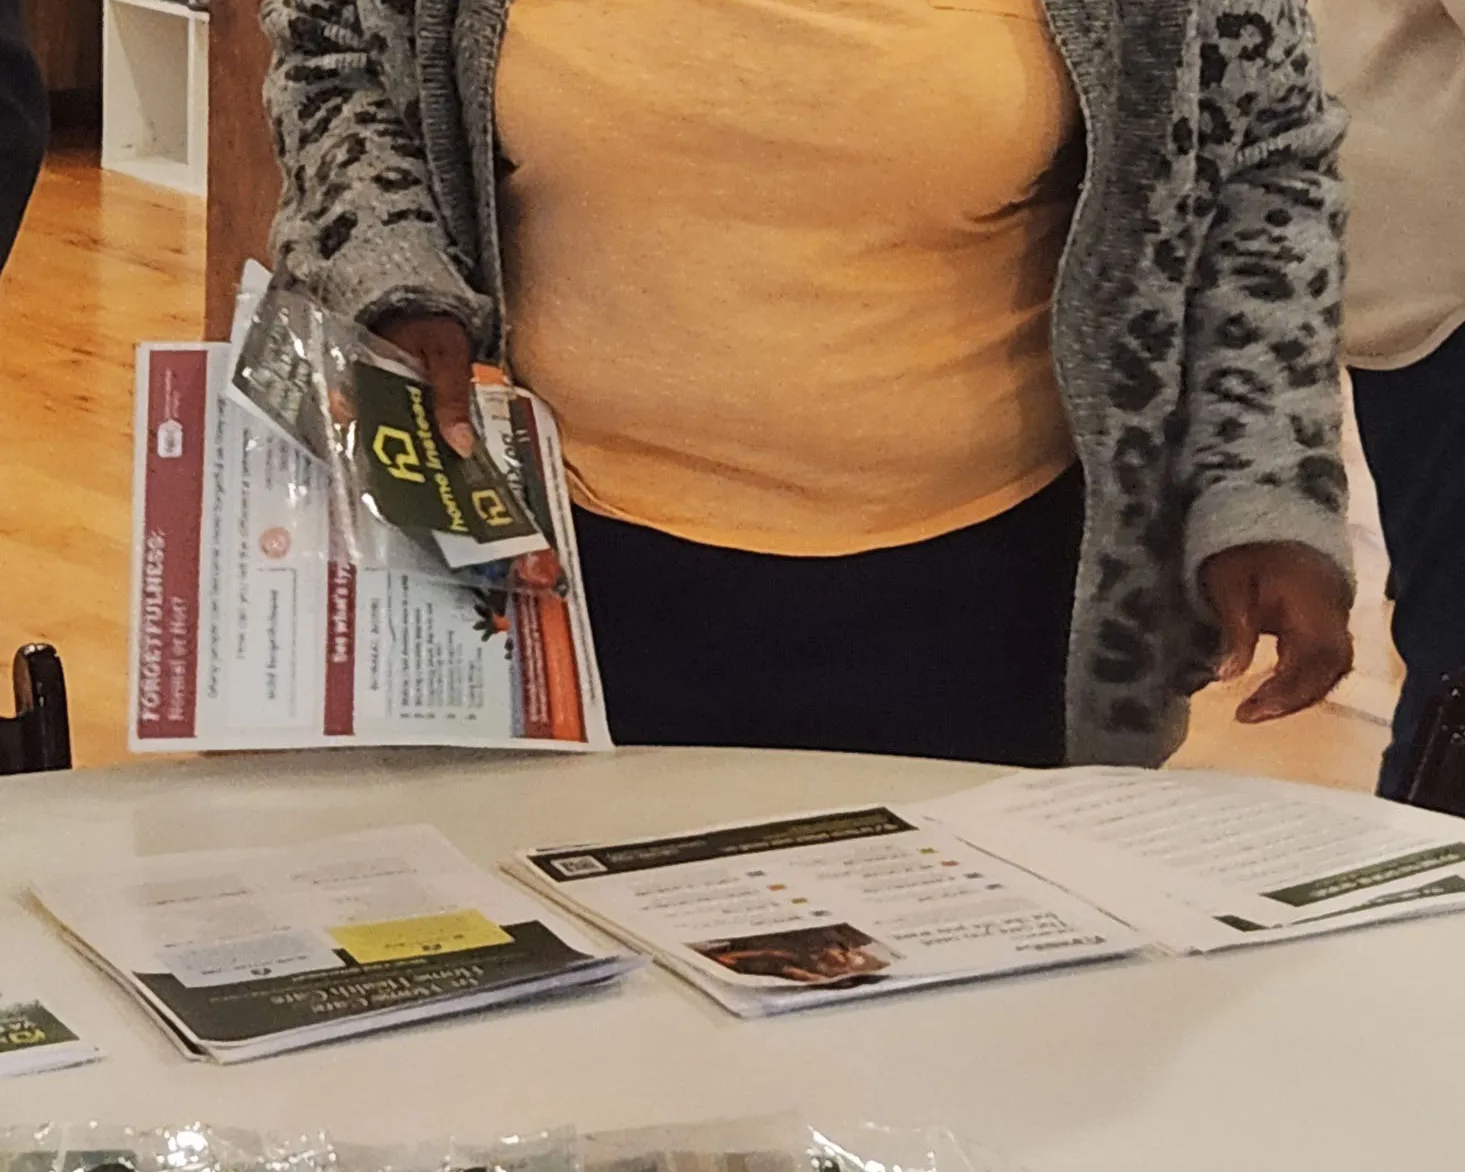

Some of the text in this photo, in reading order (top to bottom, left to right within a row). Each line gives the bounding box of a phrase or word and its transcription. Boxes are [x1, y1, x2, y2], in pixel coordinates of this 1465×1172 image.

[405, 384, 469, 531] home instead
[170, 636, 188, 657] or
[333, 637, 348, 663] See
[168, 659, 187, 721] Normal
